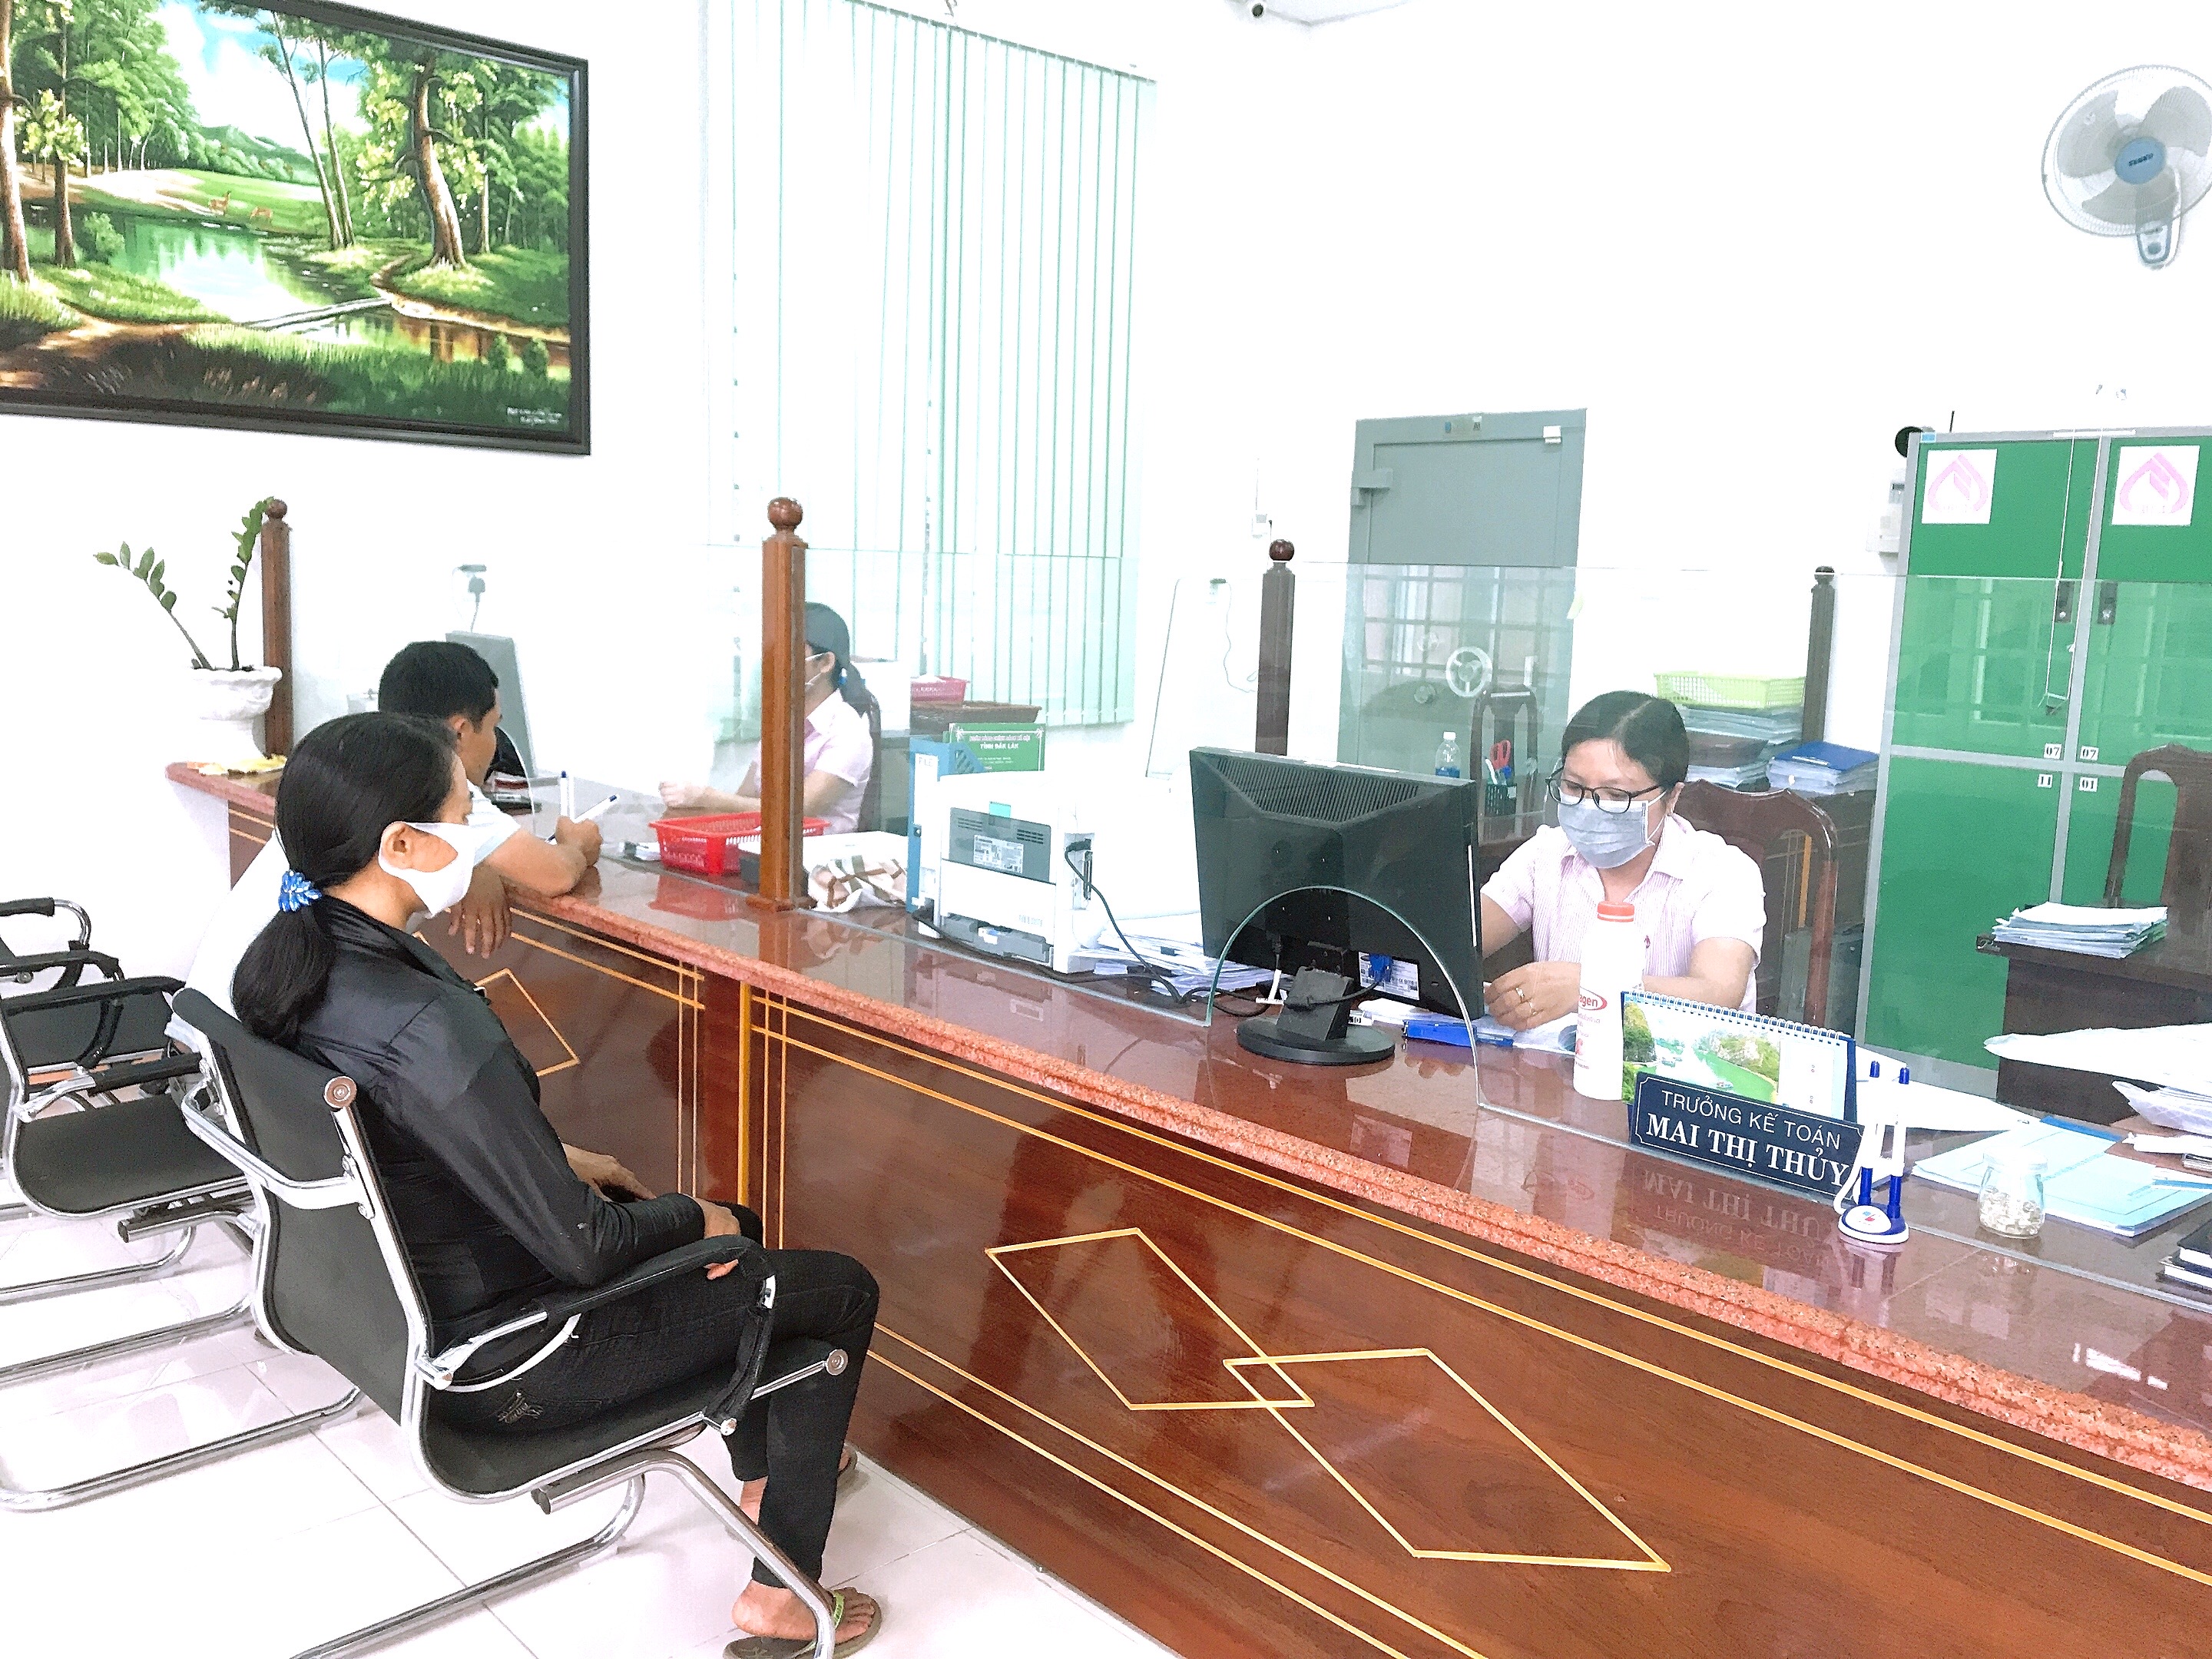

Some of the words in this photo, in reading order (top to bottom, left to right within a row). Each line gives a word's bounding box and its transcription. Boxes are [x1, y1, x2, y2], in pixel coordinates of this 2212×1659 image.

[2046, 746, 2060, 757] 07
[2082, 749, 2097, 760] 07
[2081, 779, 2094, 790] 01
[1661, 1090, 1742, 1125] TRƯỞNG
[1749, 1112, 1779, 1134] KẾ
[1783, 1120, 1842, 1151] TOÁN
[1645, 1112, 1700, 1149] MAI
[1707, 1128, 1758, 1169] THỊ
[1766, 1143, 1851, 1187] THỦY
